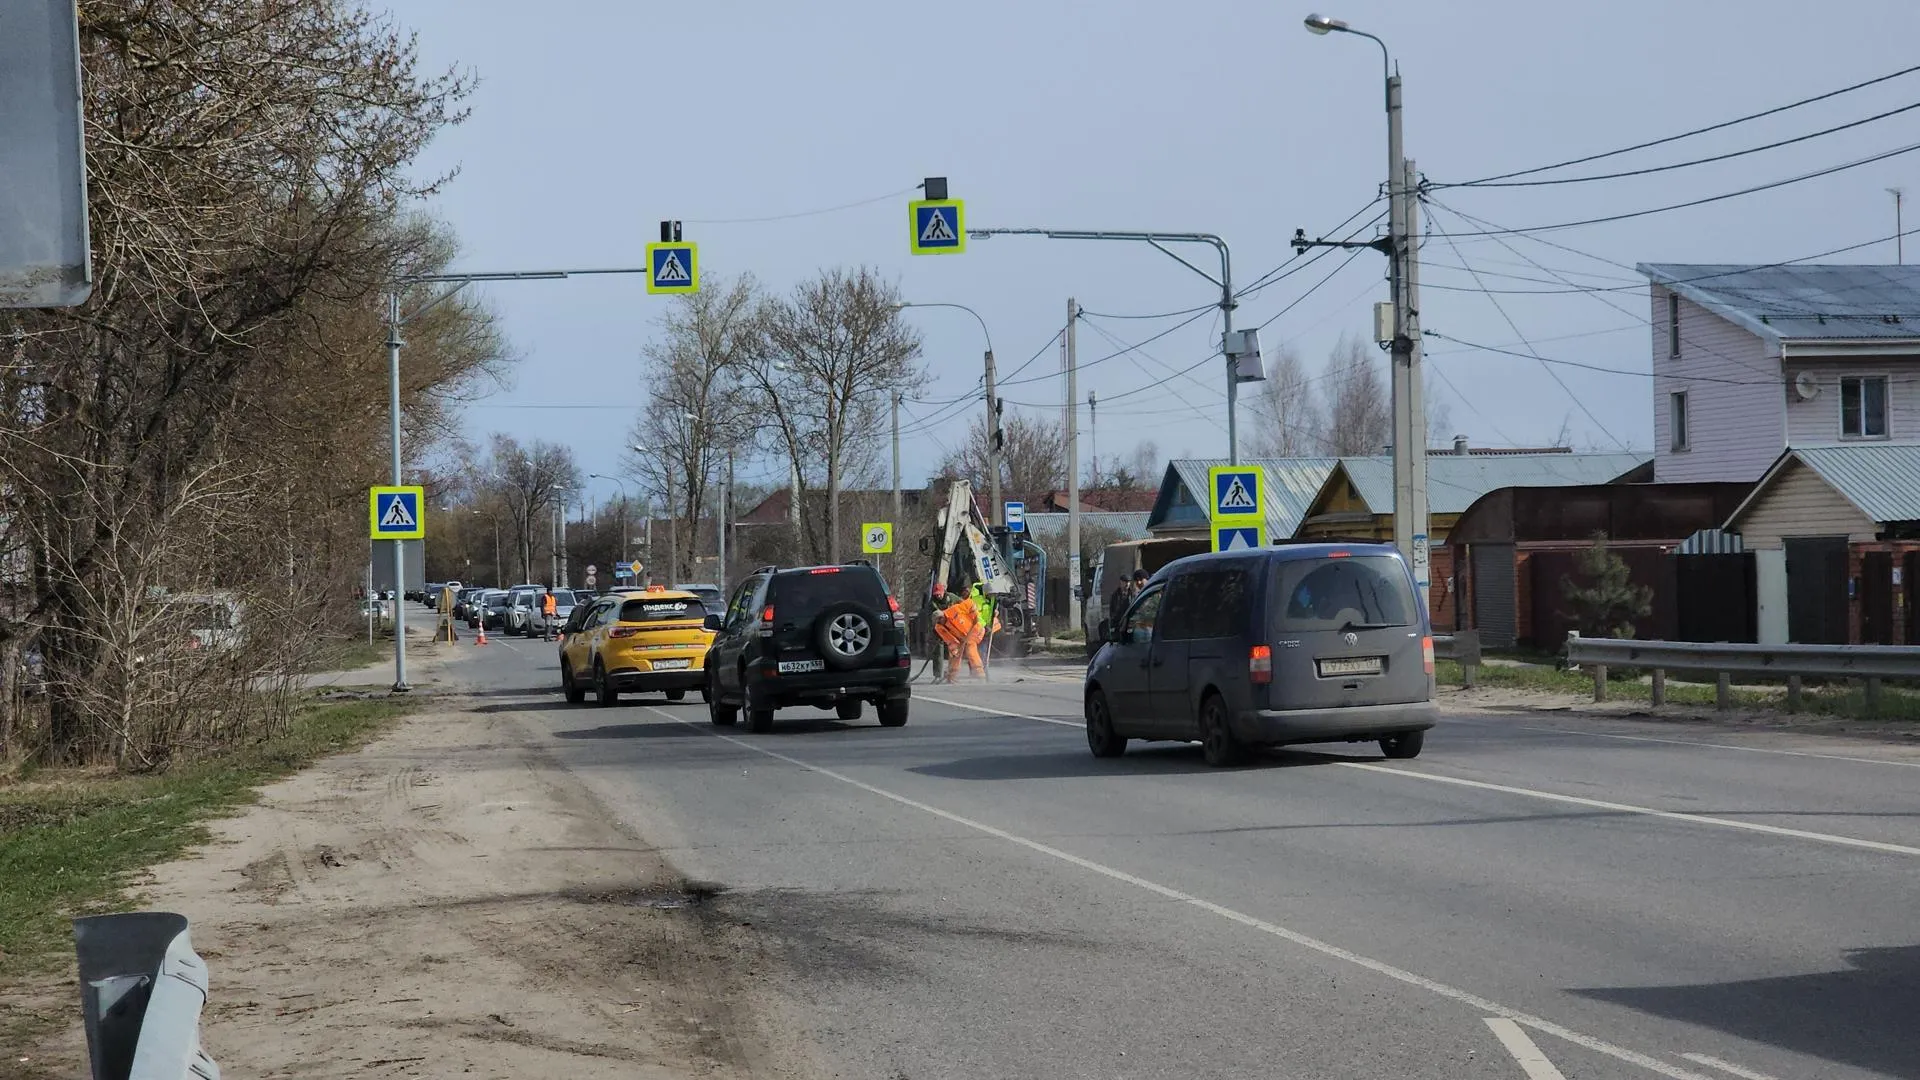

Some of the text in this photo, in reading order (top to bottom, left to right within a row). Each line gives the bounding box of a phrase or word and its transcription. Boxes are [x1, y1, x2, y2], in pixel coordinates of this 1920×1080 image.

[871, 533, 884, 543] 30
[981, 556, 993, 580] 82
[991, 557, 1000, 576] TLB
